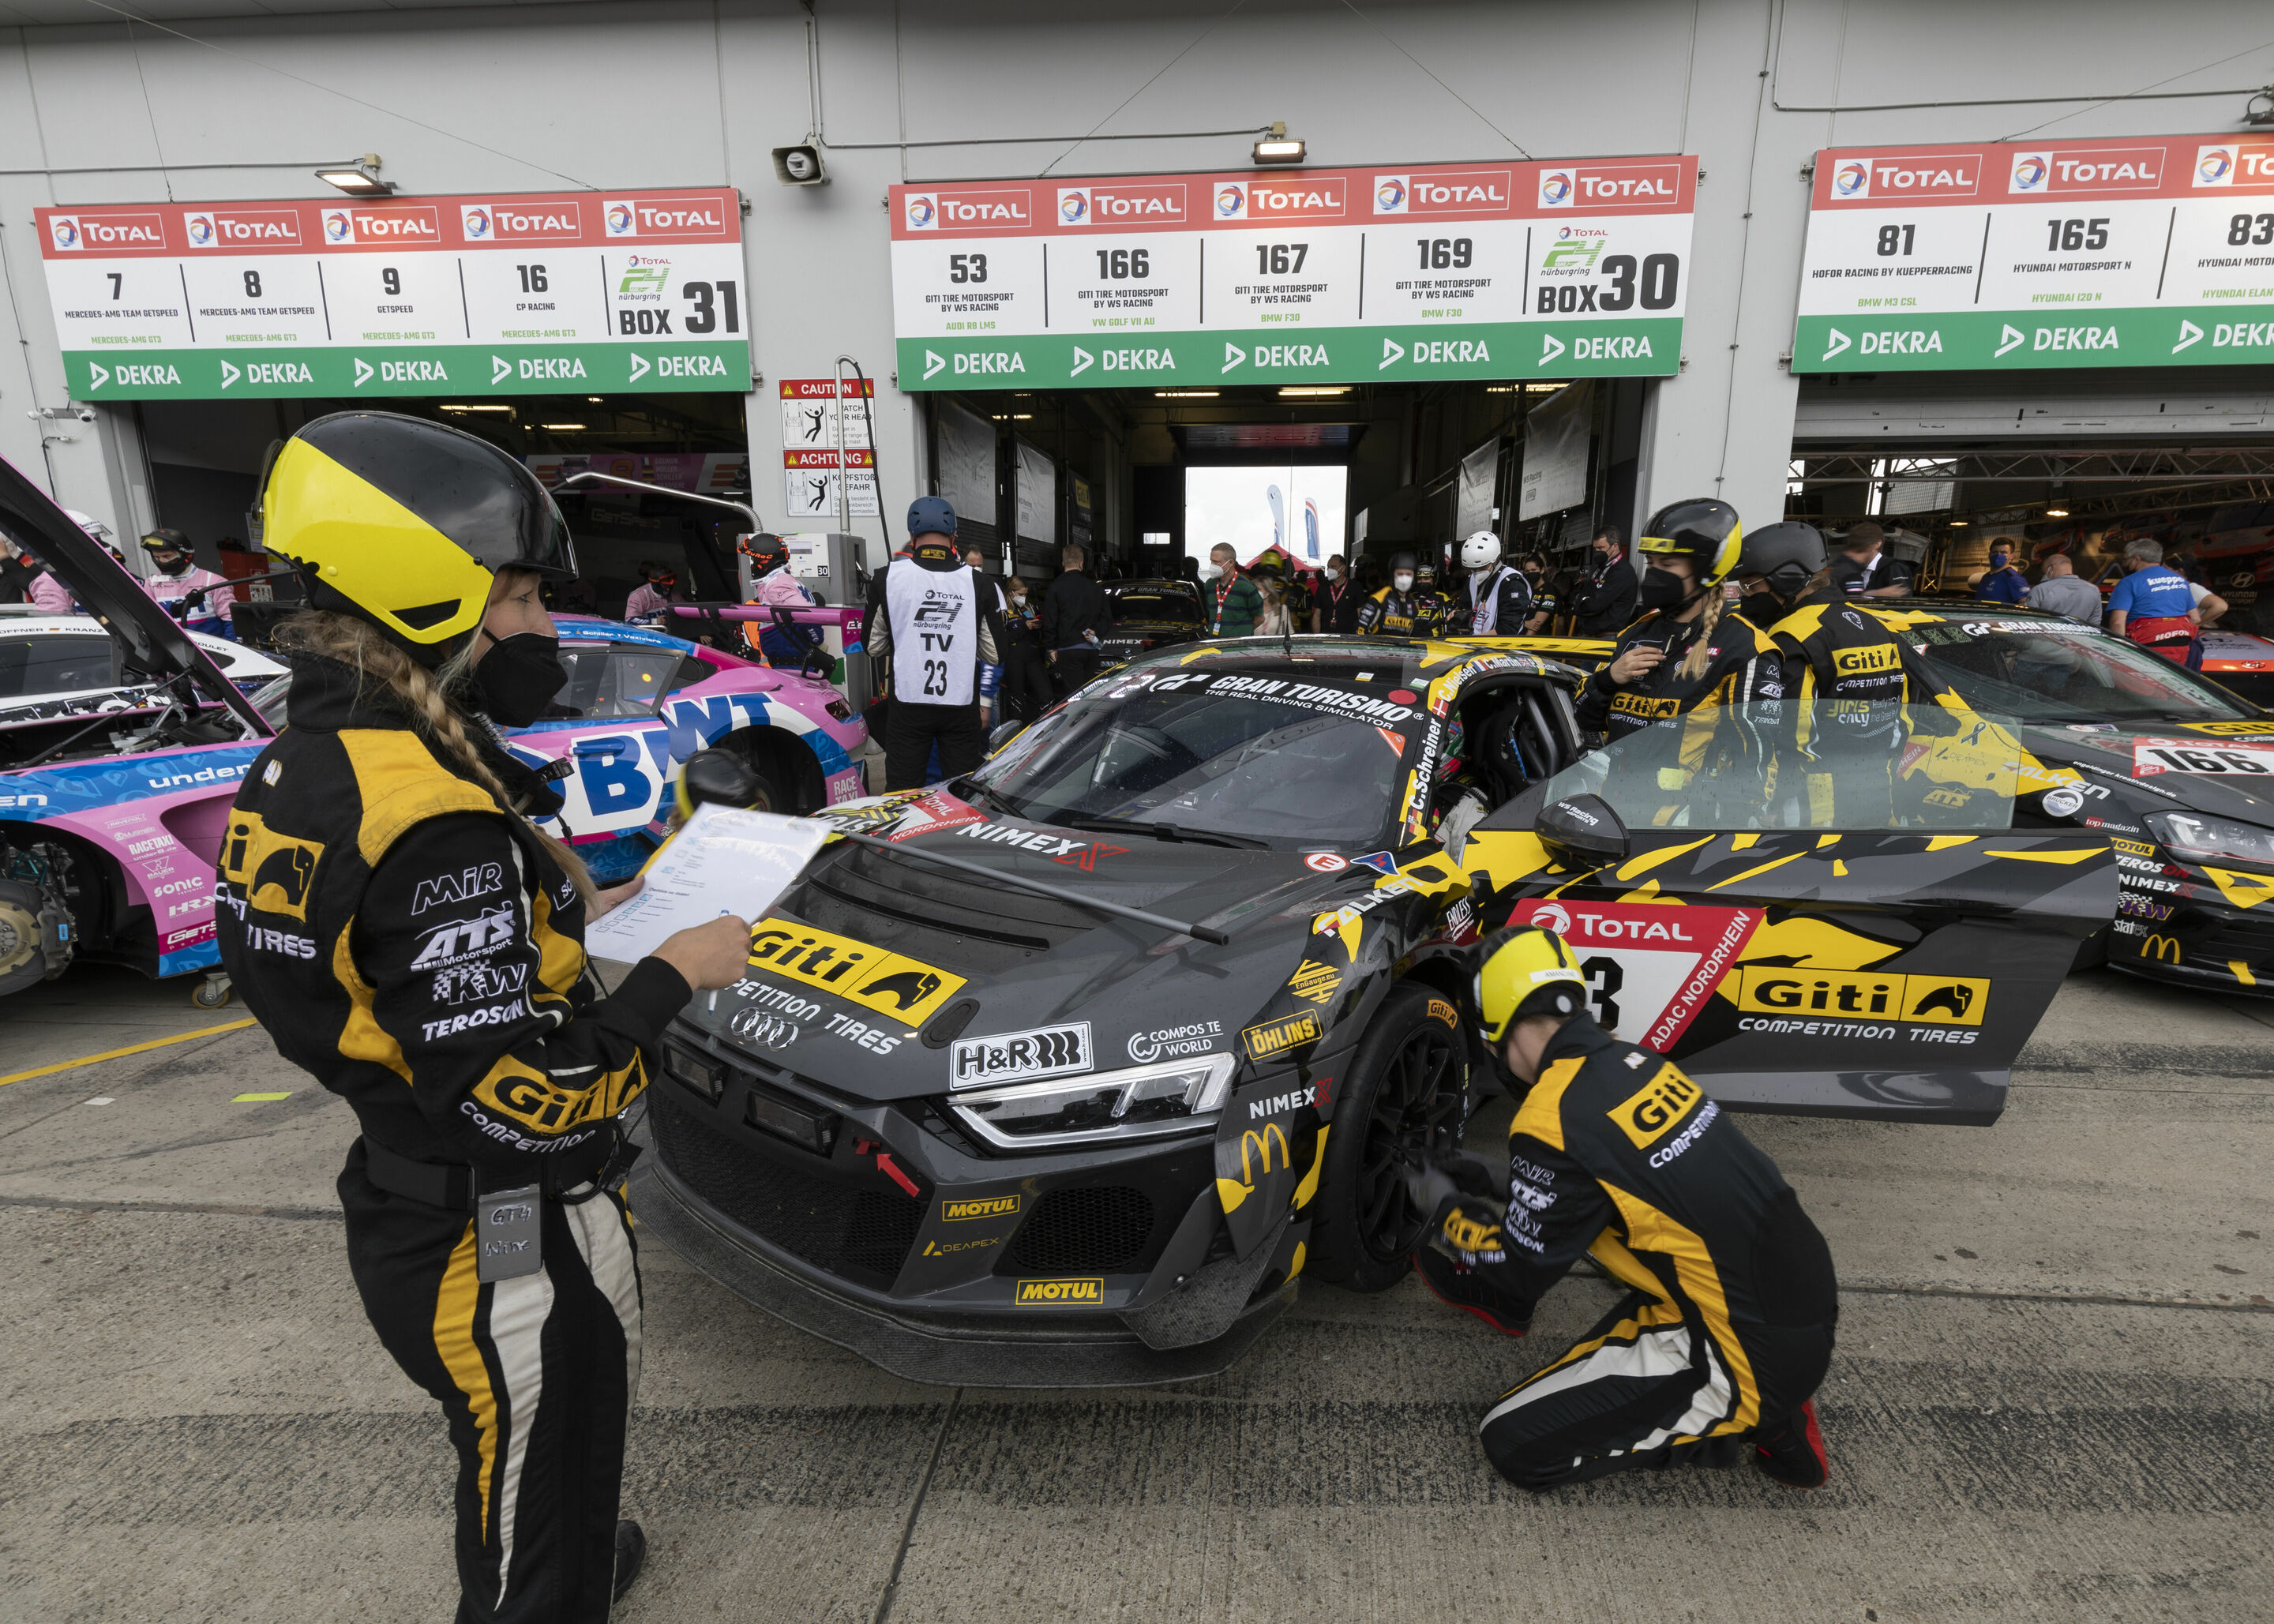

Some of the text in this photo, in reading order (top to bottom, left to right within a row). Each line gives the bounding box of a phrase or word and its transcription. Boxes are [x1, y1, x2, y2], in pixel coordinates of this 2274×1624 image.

[1876, 167, 1973, 188] TOTAL
[2056, 160, 2156, 182] TOTAL
[1414, 182, 1504, 203] TOTAL
[1580, 176, 1673, 197] TOTAL
[1094, 195, 1181, 215] TOTAL
[1252, 189, 1340, 210] TOTAL
[639, 208, 720, 227] TOTAL
[942, 201, 1026, 220] TOTAL
[218, 219, 297, 238] TOTAL
[356, 216, 435, 235] TOTAL
[496, 212, 576, 231] TOTAL
[2227, 213, 2274, 246] 83
[83, 223, 160, 242] TOTAL
[1877, 224, 1916, 257] 81
[2047, 217, 2110, 252] 165
[1096, 249, 1150, 279] 166
[1255, 243, 1309, 276] 167
[1417, 238, 1473, 270] 169
[950, 253, 987, 283] 53
[1540, 266, 1590, 277] nürburgring
[1812, 264, 1972, 279] HOFOR RACING BY KUEPPERRACING
[2013, 261, 2132, 273] HYUNDAI MOTORSPORT N
[107, 272, 122, 300] 7
[243, 270, 262, 298] 8
[382, 268, 400, 295] 9
[516, 264, 548, 293] 16
[1235, 283, 1328, 295] GITI TIRE MOTORSPORT
[1395, 279, 1492, 290] GITI TIRE MOTORSPORT
[1537, 253, 1679, 313] BOX 30
[618, 291, 661, 302] nürburgring
[925, 291, 1014, 303] GITI TIRE MOTORSPORT
[1078, 288, 1169, 299] GITI TIRE MOTORSPORT
[1094, 298, 1153, 309] BY WS RACING
[1250, 294, 1311, 304] BY WS RACING
[1411, 288, 1474, 299] BY WS RACING
[1857, 297, 1918, 306] BMW M3 CSL
[2032, 293, 2074, 303] HYUNDAI
[2093, 292, 2102, 302] N
[65, 309, 120, 319] MERCEDES-AMG
[143, 309, 178, 317] GETSPEED
[200, 307, 315, 317] MERCEDES-AMG TEAM GETSPEED
[377, 306, 413, 314] GETSPEED
[516, 302, 555, 312] CP RACING
[619, 280, 740, 336] BOX 31
[941, 302, 999, 313] BY WS RACING
[1261, 313, 1300, 322] BMW F30
[1421, 309, 1462, 318] BMW F30
[945, 321, 996, 330] AUDI R8 LMS
[1092, 317, 1155, 327] VW GOLF VII AU
[1574, 335, 1653, 360] DEKRA
[1860, 330, 1943, 354] DEKRA
[2033, 326, 2119, 351] DEKRA
[1103, 348, 1176, 370] DEKRA
[1255, 343, 1330, 367] DEKRA
[1413, 339, 1491, 363] DEKRA
[247, 363, 314, 384] DEKRA
[381, 360, 448, 382] DEKRA
[519, 358, 587, 379] DEKRA
[658, 355, 727, 377] DEKRA
[954, 352, 1026, 374] DEKRA
[115, 364, 182, 385] DEKRA
[818, 567, 827, 576] 30
[913, 621, 951, 630] nürburgring
[920, 633, 954, 652] TV
[1839, 650, 1884, 671] Giti
[923, 659, 948, 696] 23
[1438, 663, 1477, 702] C.Nielsen
[1209, 676, 1413, 722] GRAN TURISMO
[1228, 692, 1259, 700] REAL
[1260, 695, 1312, 709] DRIVING
[1315, 704, 1394, 730] SIMULATOR
[576, 692, 775, 817] BWT
[1409, 718, 1442, 810] C.Schreiner
[2146, 749, 2269, 773] 166
[834, 776, 857, 797] RACE
[921, 795, 955, 816] TOTAL
[1570, 806, 1600, 827] Racing
[2085, 818, 2140, 834] top magazin
[891, 815, 981, 840] NORDRHEIN
[128, 835, 175, 856] RACETAXI
[153, 876, 203, 898] SONIC
[1315, 876, 1424, 937] FALKEN
[1446, 895, 1471, 932] ENDLESS
[2122, 900, 2175, 921] KW
[414, 909, 513, 965] ATS
[1577, 913, 1693, 942] TOTAL
[444, 939, 513, 968] Motorsport
[751, 929, 865, 984] Giti
[448, 962, 527, 1006] KW
[1296, 971, 1335, 990] EnGauge.eu
[1650, 910, 1751, 1050] ADAC NORDRHEIN
[1754, 979, 1889, 1014] Giti
[824, 1013, 902, 1055] TIRES
[1250, 1018, 1317, 1056] ÖHLINS
[1739, 1017, 1979, 1045] COMPETITION TIRES
[1165, 1038, 1213, 1056] WORLD
[957, 1038, 1036, 1078] H&R
[1632, 1074, 1696, 1133] Giti
[948, 1199, 1016, 1217] MOTUL
[1021, 1282, 1098, 1300] MOTUL
